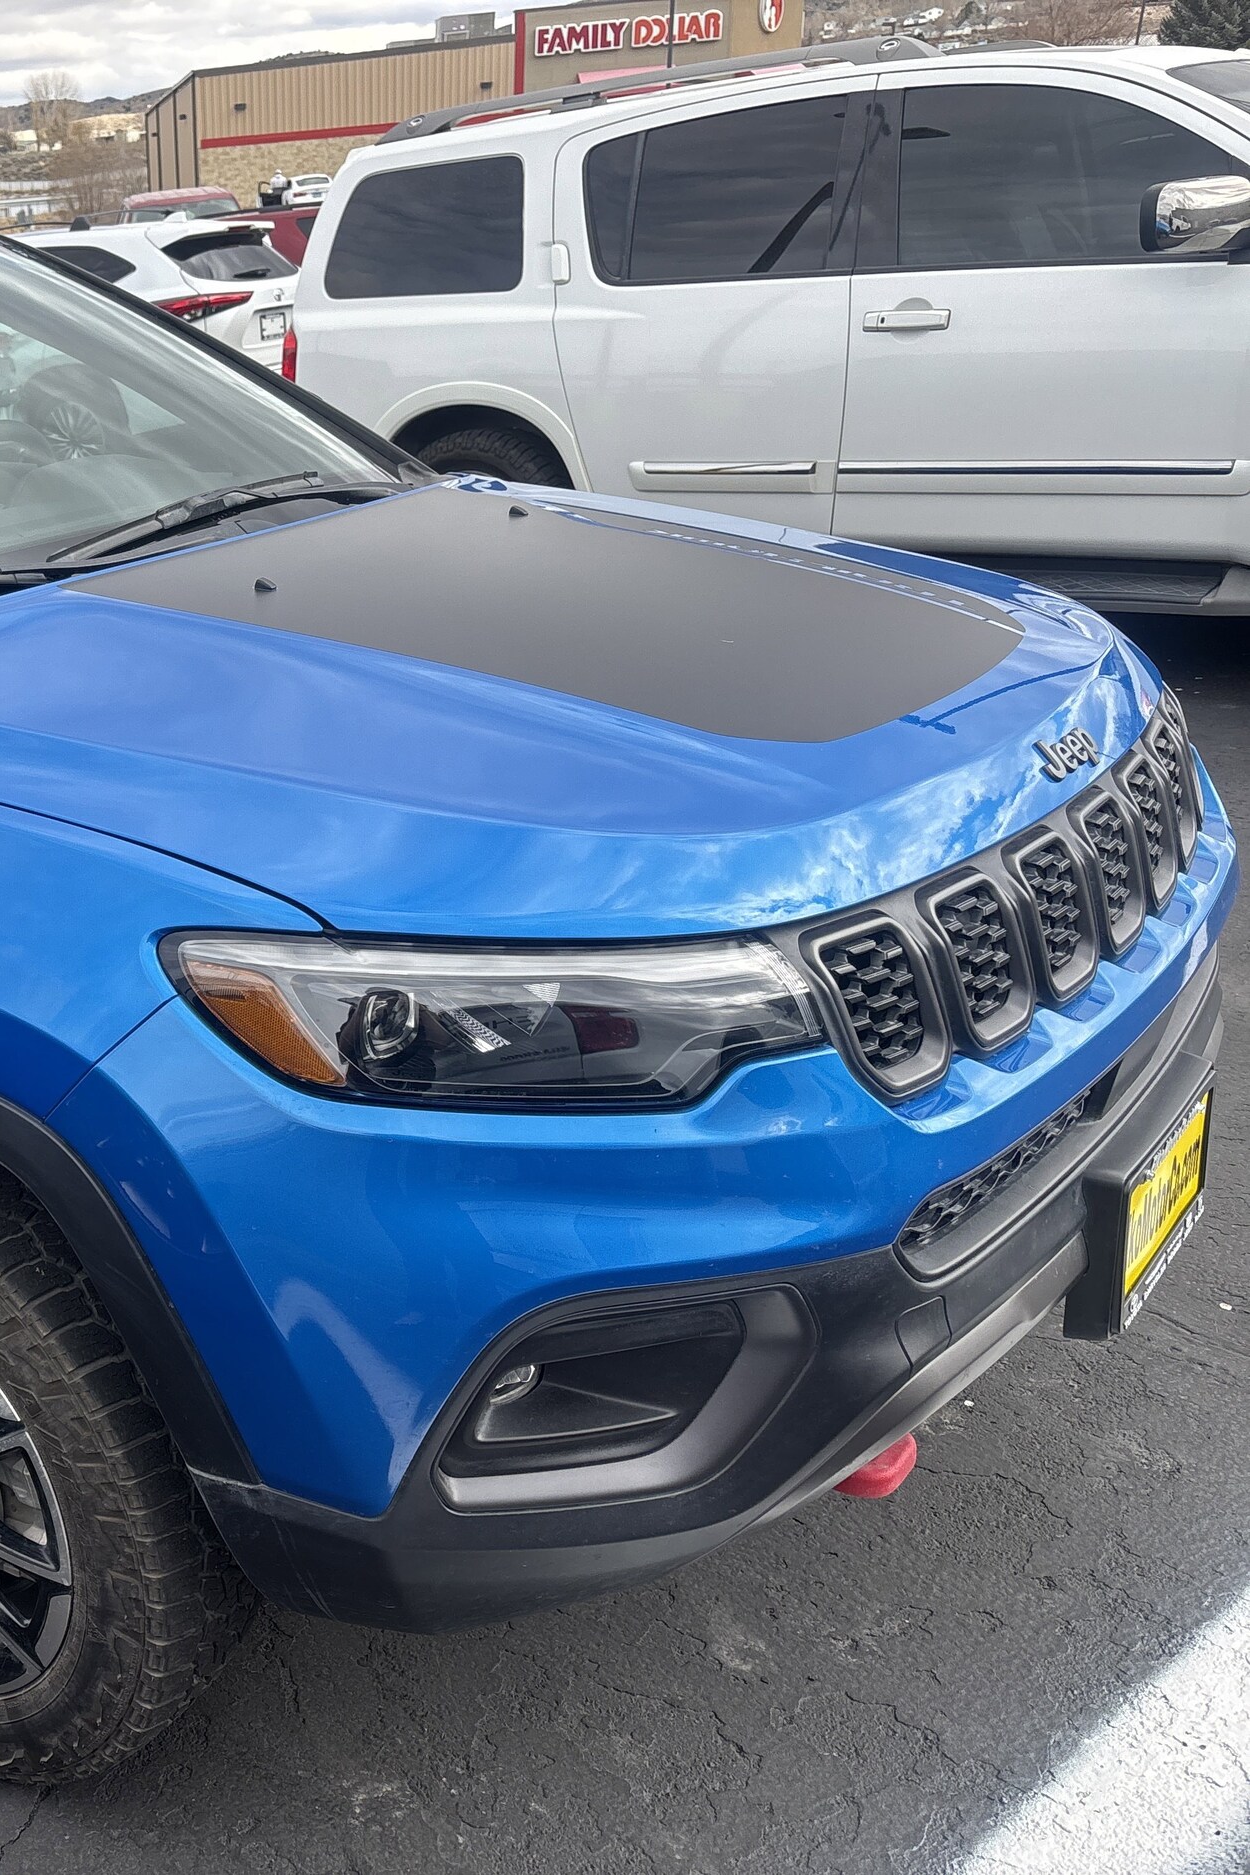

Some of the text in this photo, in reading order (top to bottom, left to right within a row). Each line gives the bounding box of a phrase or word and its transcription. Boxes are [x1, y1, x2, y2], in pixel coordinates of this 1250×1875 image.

[536, 10, 723, 57] FAMILY DOLLAR
[1032, 727, 1100, 783] Jeep
[1127, 1134, 1201, 1269] koMotorCo.com
